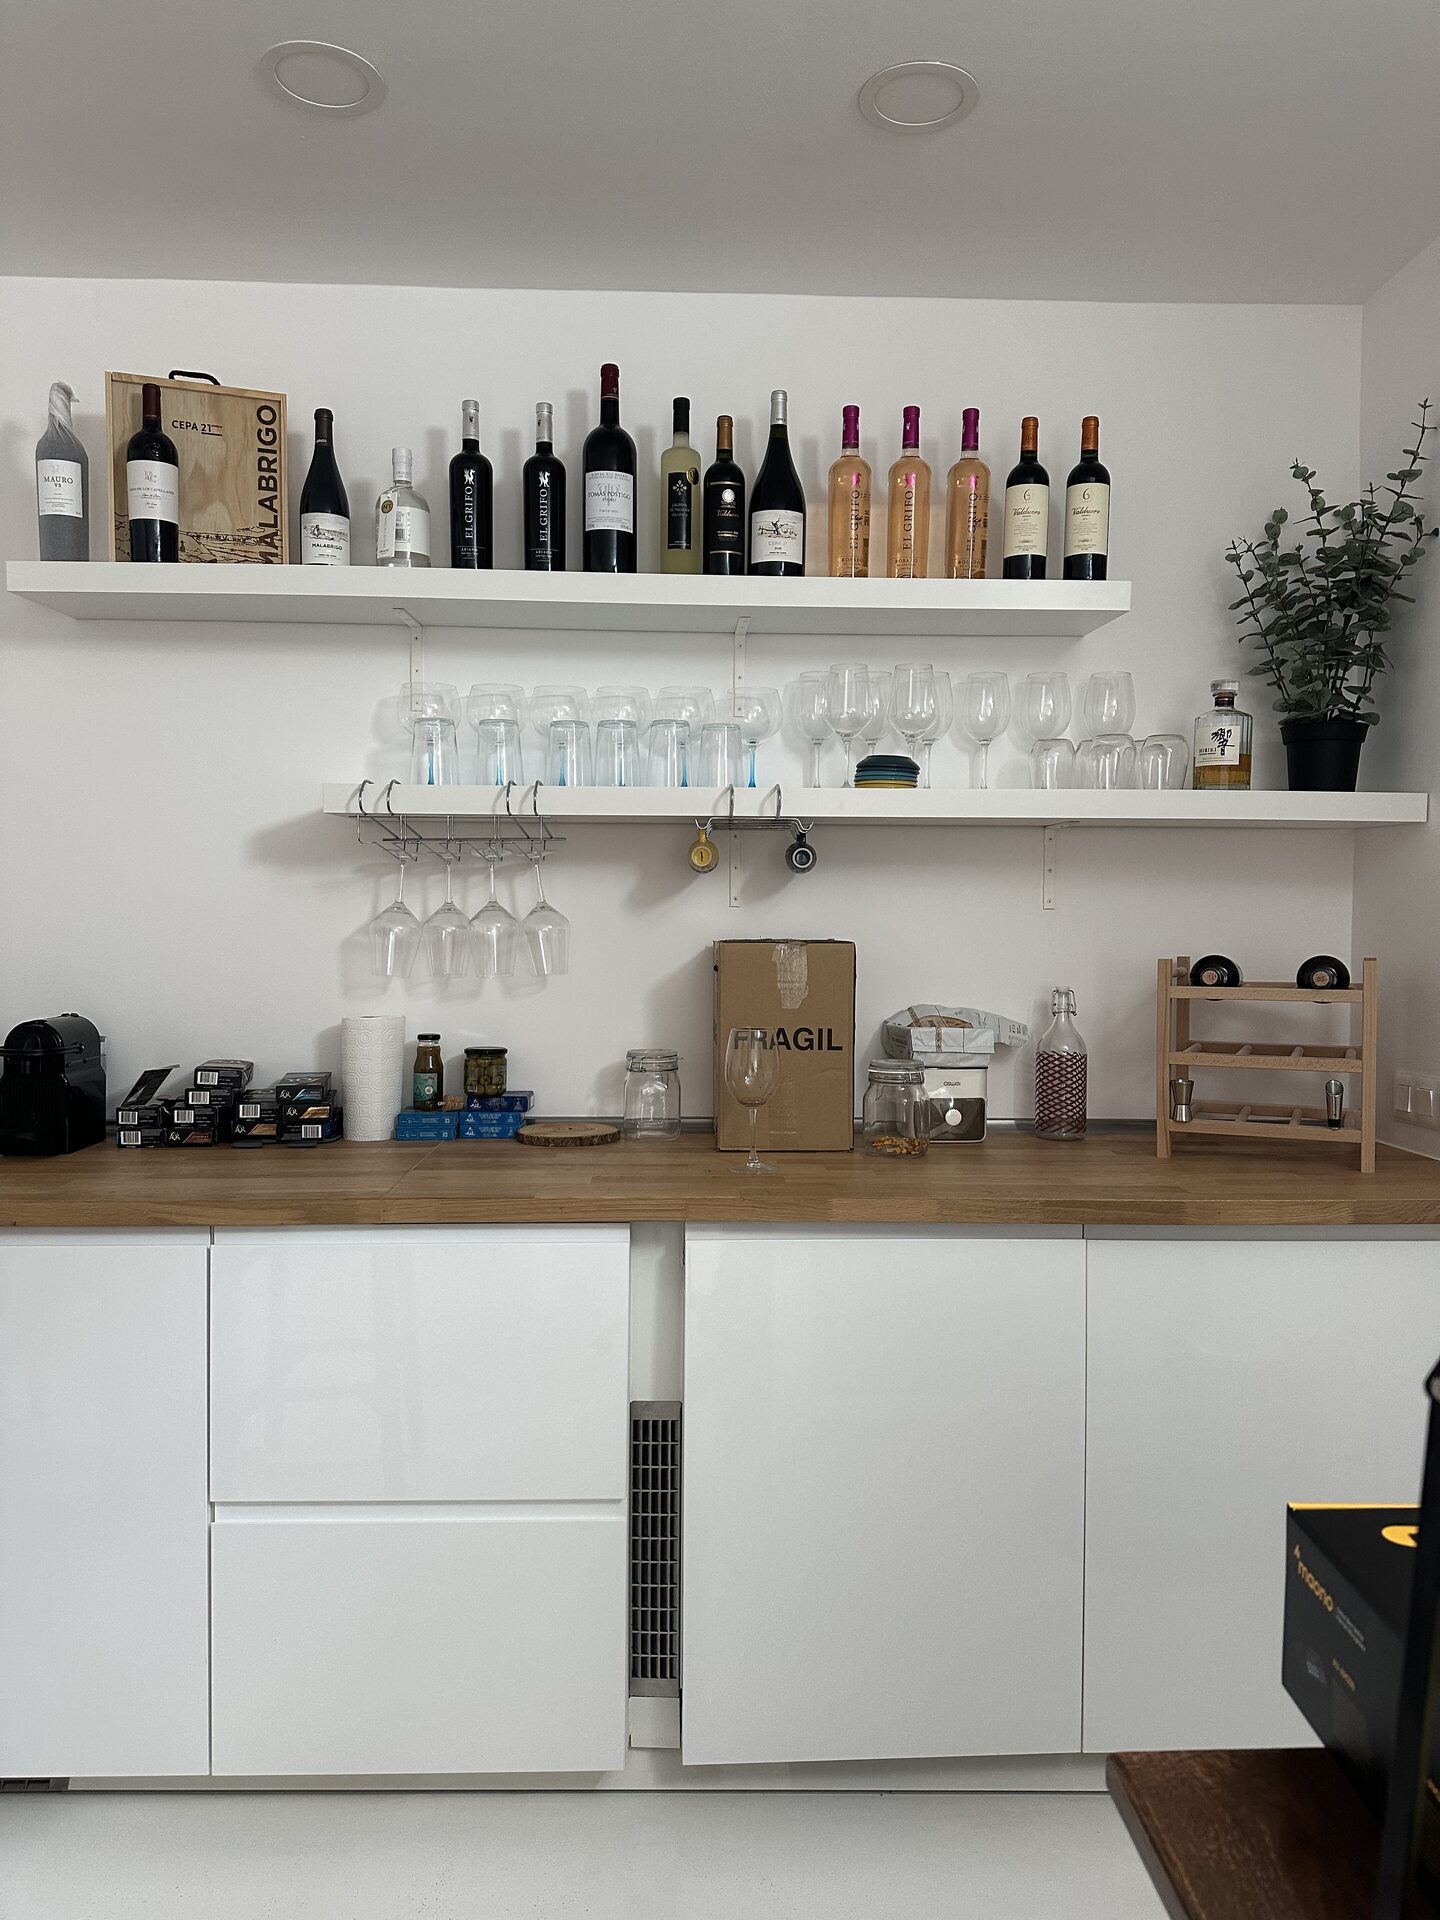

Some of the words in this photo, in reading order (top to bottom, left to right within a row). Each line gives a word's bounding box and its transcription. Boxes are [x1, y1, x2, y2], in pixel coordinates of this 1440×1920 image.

[171, 420, 199, 431] CEPA
[201, 423, 212, 432] 21
[43, 475, 74, 484] MAURO
[256, 404, 279, 563] MALABRIGO
[1023, 488, 1032, 501] 6
[1082, 487, 1091, 501] 6
[464, 486, 474, 523] GRIFO
[539, 488, 548, 526] GRIFO
[850, 489, 860, 531] GRIFO
[903, 490, 914, 532] GRIFO
[465, 525, 474, 539] EL
[539, 527, 548, 542] EL
[312, 543, 343, 551] MALABRIGO
[850, 533, 859, 550] EL
[903, 536, 912, 550] EL
[734, 1027, 843, 1051] FRAGIL
